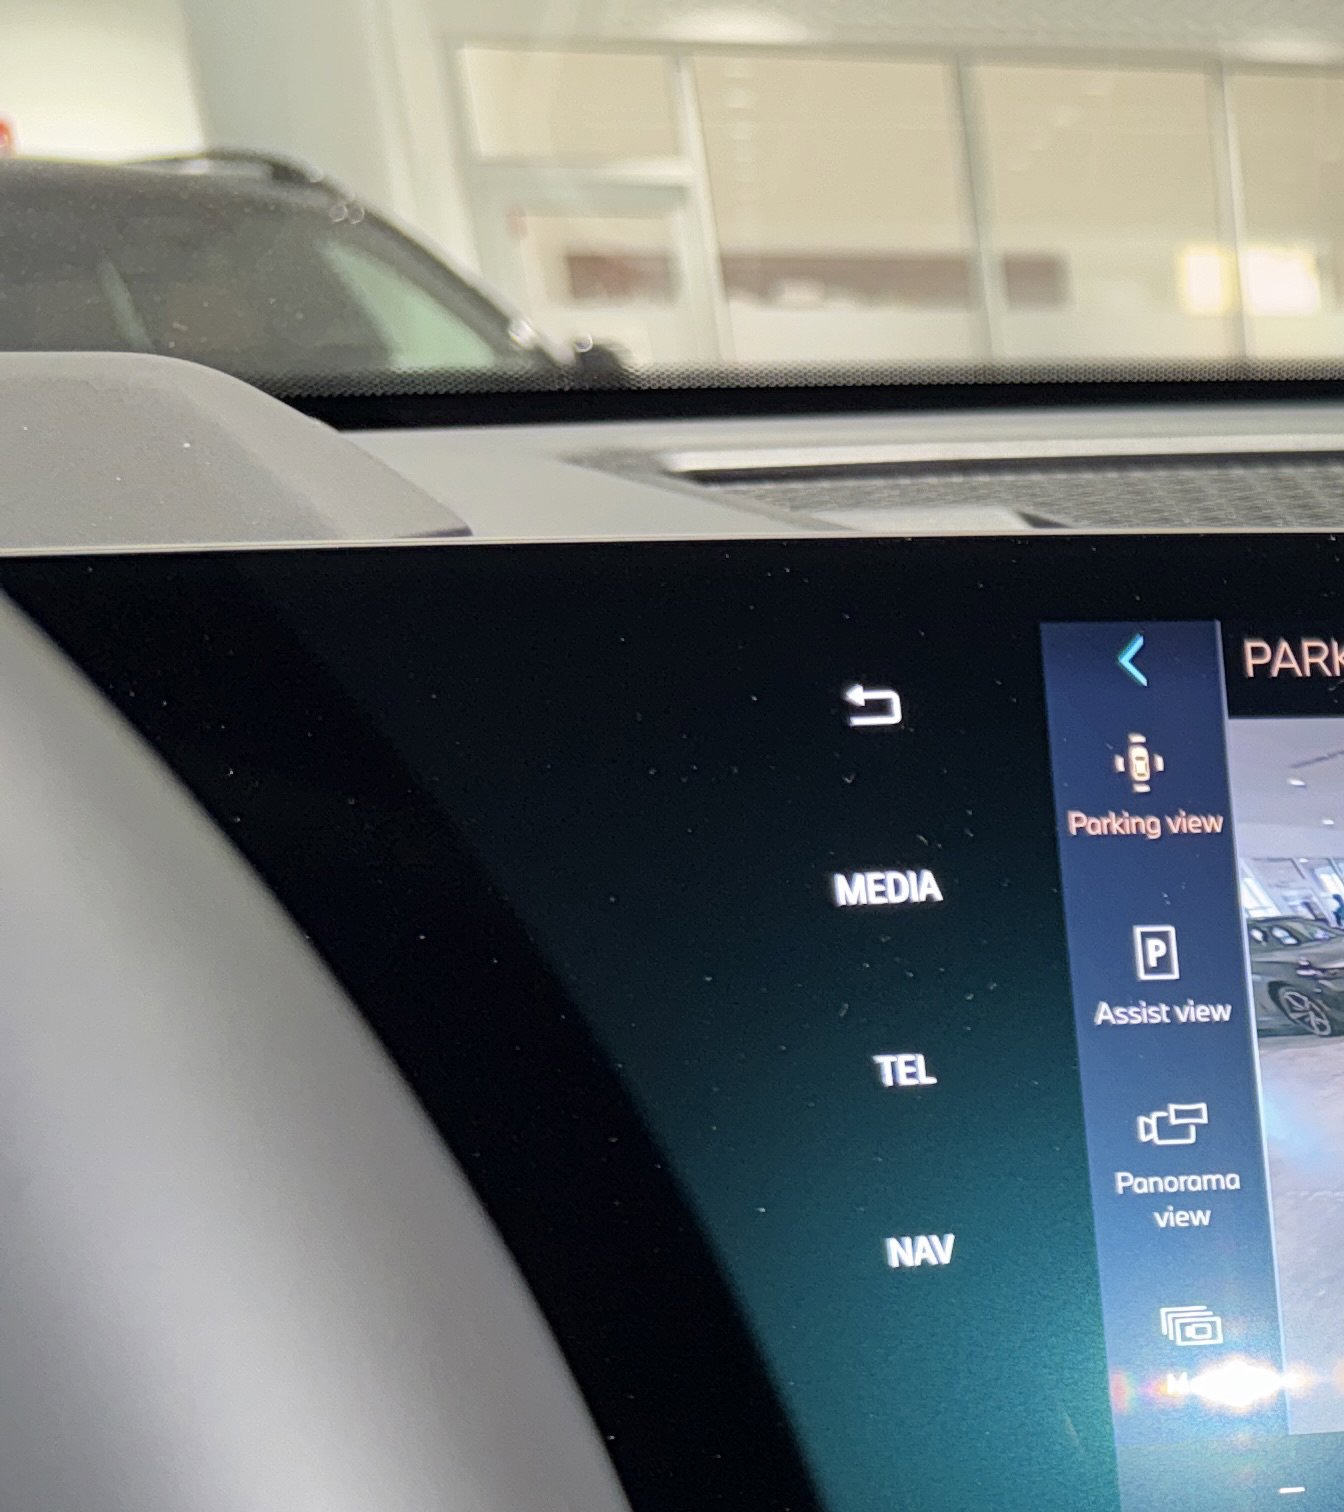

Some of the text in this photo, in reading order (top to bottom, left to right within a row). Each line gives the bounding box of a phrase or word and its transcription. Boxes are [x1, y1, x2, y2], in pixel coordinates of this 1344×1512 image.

[1067, 809, 1224, 840] Parking view
[834, 870, 943, 907] MEDIA
[1094, 999, 1232, 1026] Assist view
[873, 1054, 937, 1088] TEL
[1114, 1171, 1241, 1195] Panorama
[1153, 1206, 1212, 1228] view
[885, 1233, 956, 1269] NAV
